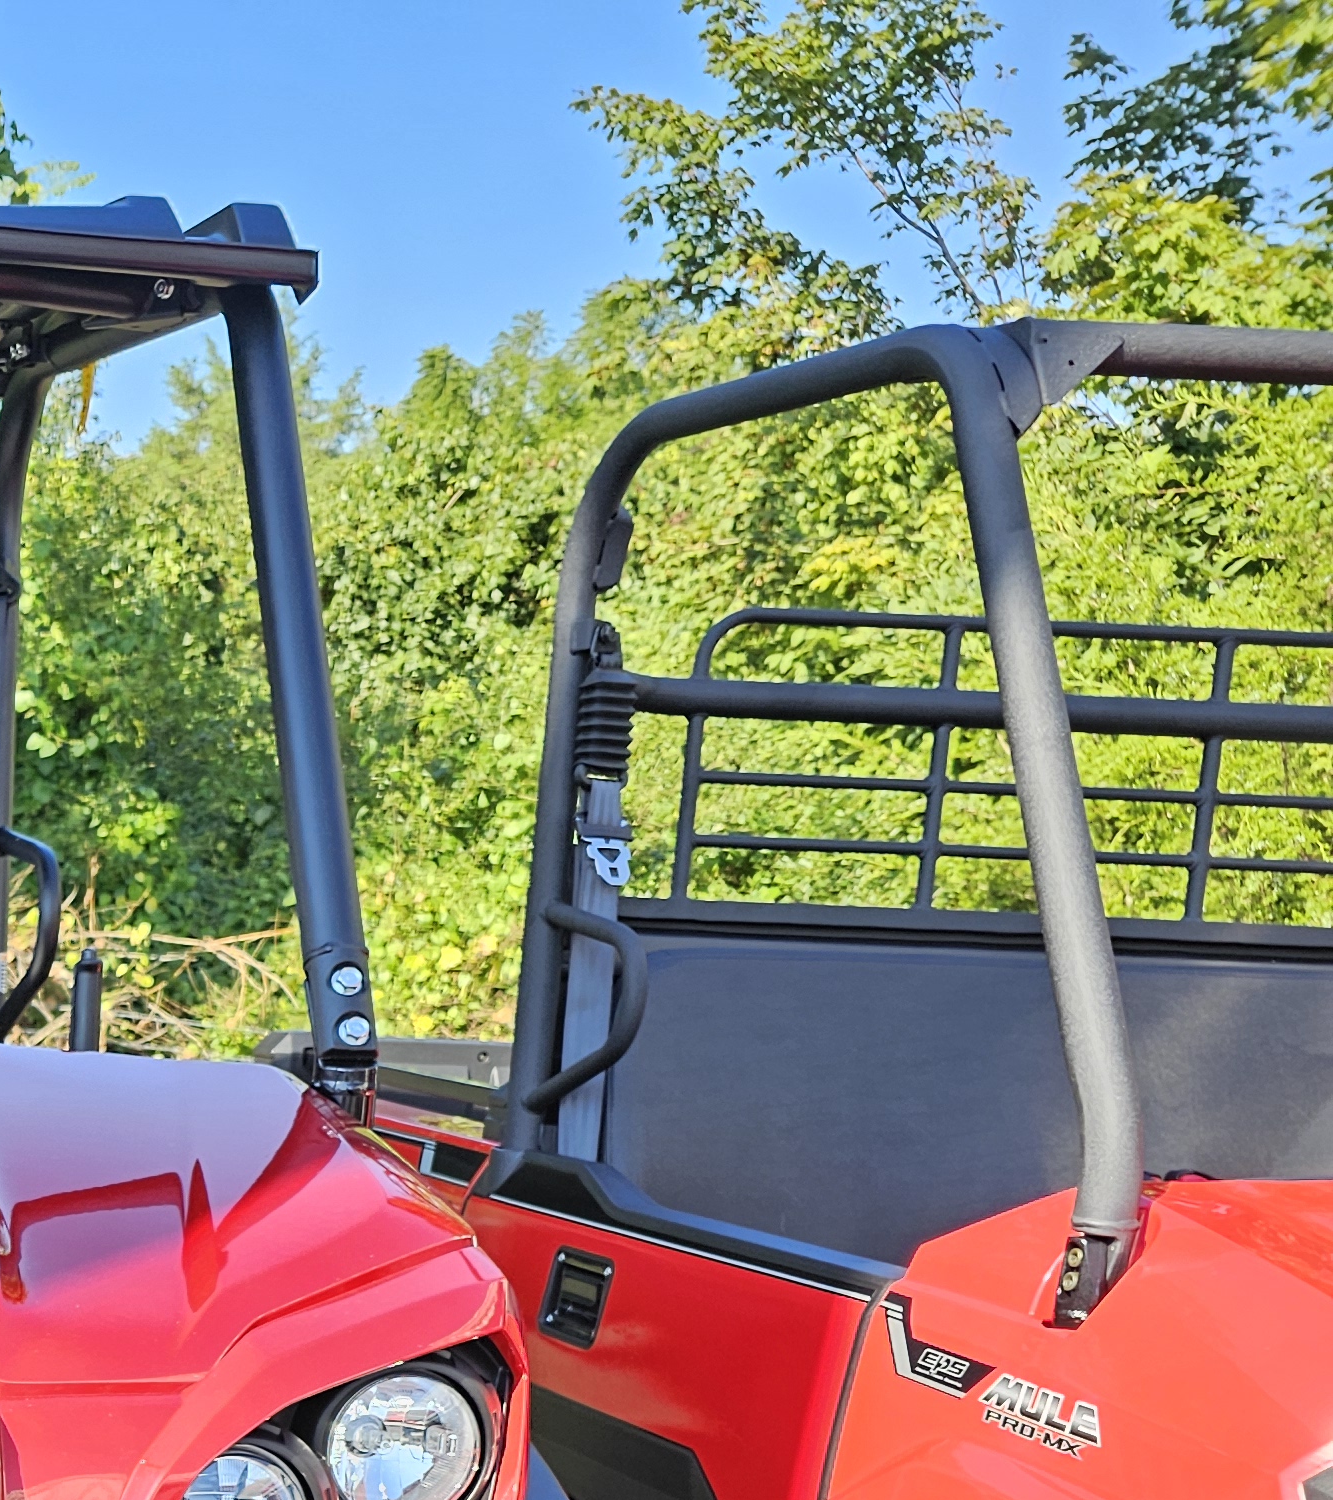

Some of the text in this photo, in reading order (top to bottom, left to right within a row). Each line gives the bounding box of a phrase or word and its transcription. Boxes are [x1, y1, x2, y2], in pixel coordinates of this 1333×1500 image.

[916, 1348, 971, 1380] EPS
[979, 1373, 1101, 1448] MULE
[983, 1407, 1083, 1459] PRO-MX
